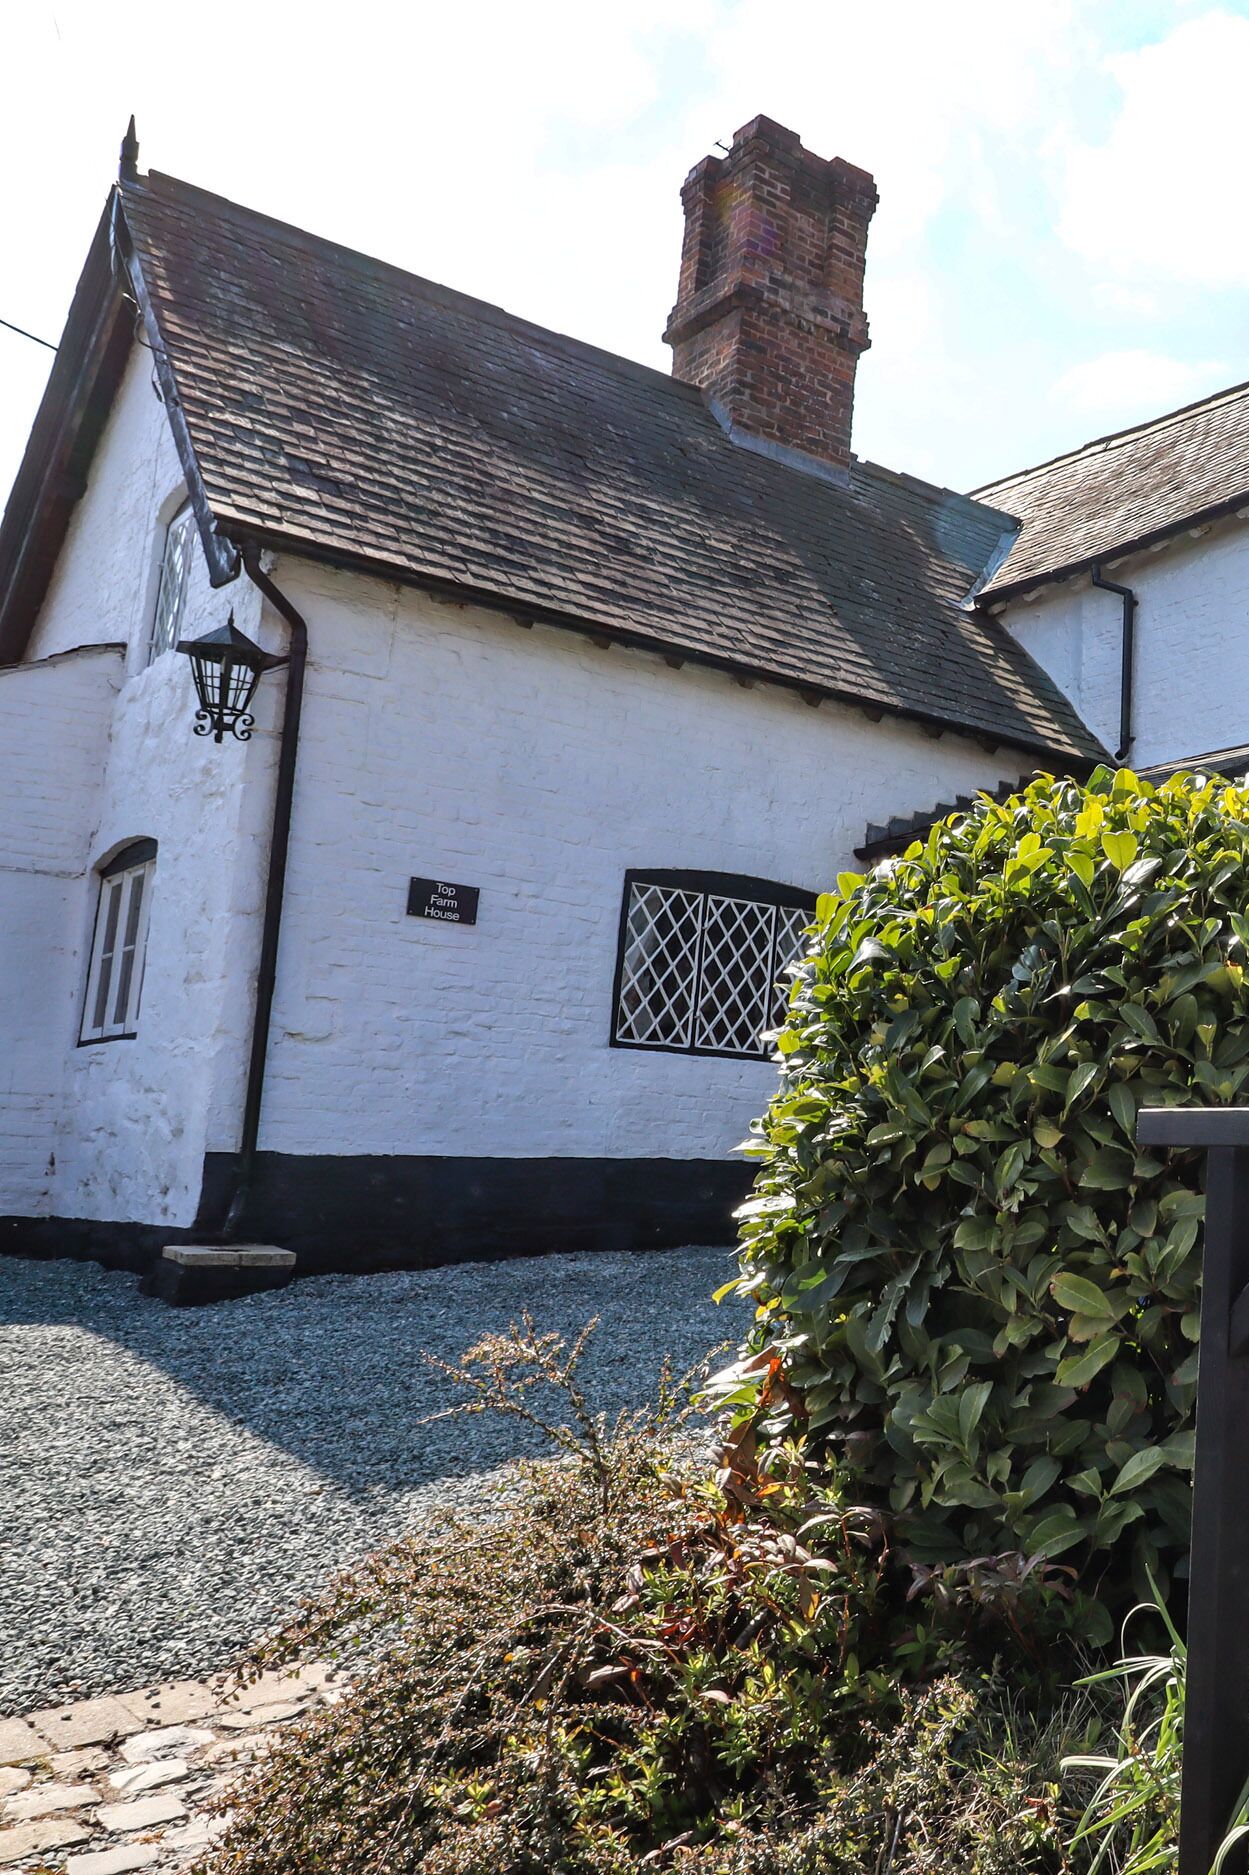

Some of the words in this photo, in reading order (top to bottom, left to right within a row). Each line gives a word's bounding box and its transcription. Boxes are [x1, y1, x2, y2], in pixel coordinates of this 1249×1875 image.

[436, 883, 456, 896] Top
[430, 894, 457, 908] Farm
[424, 906, 460, 921] House
